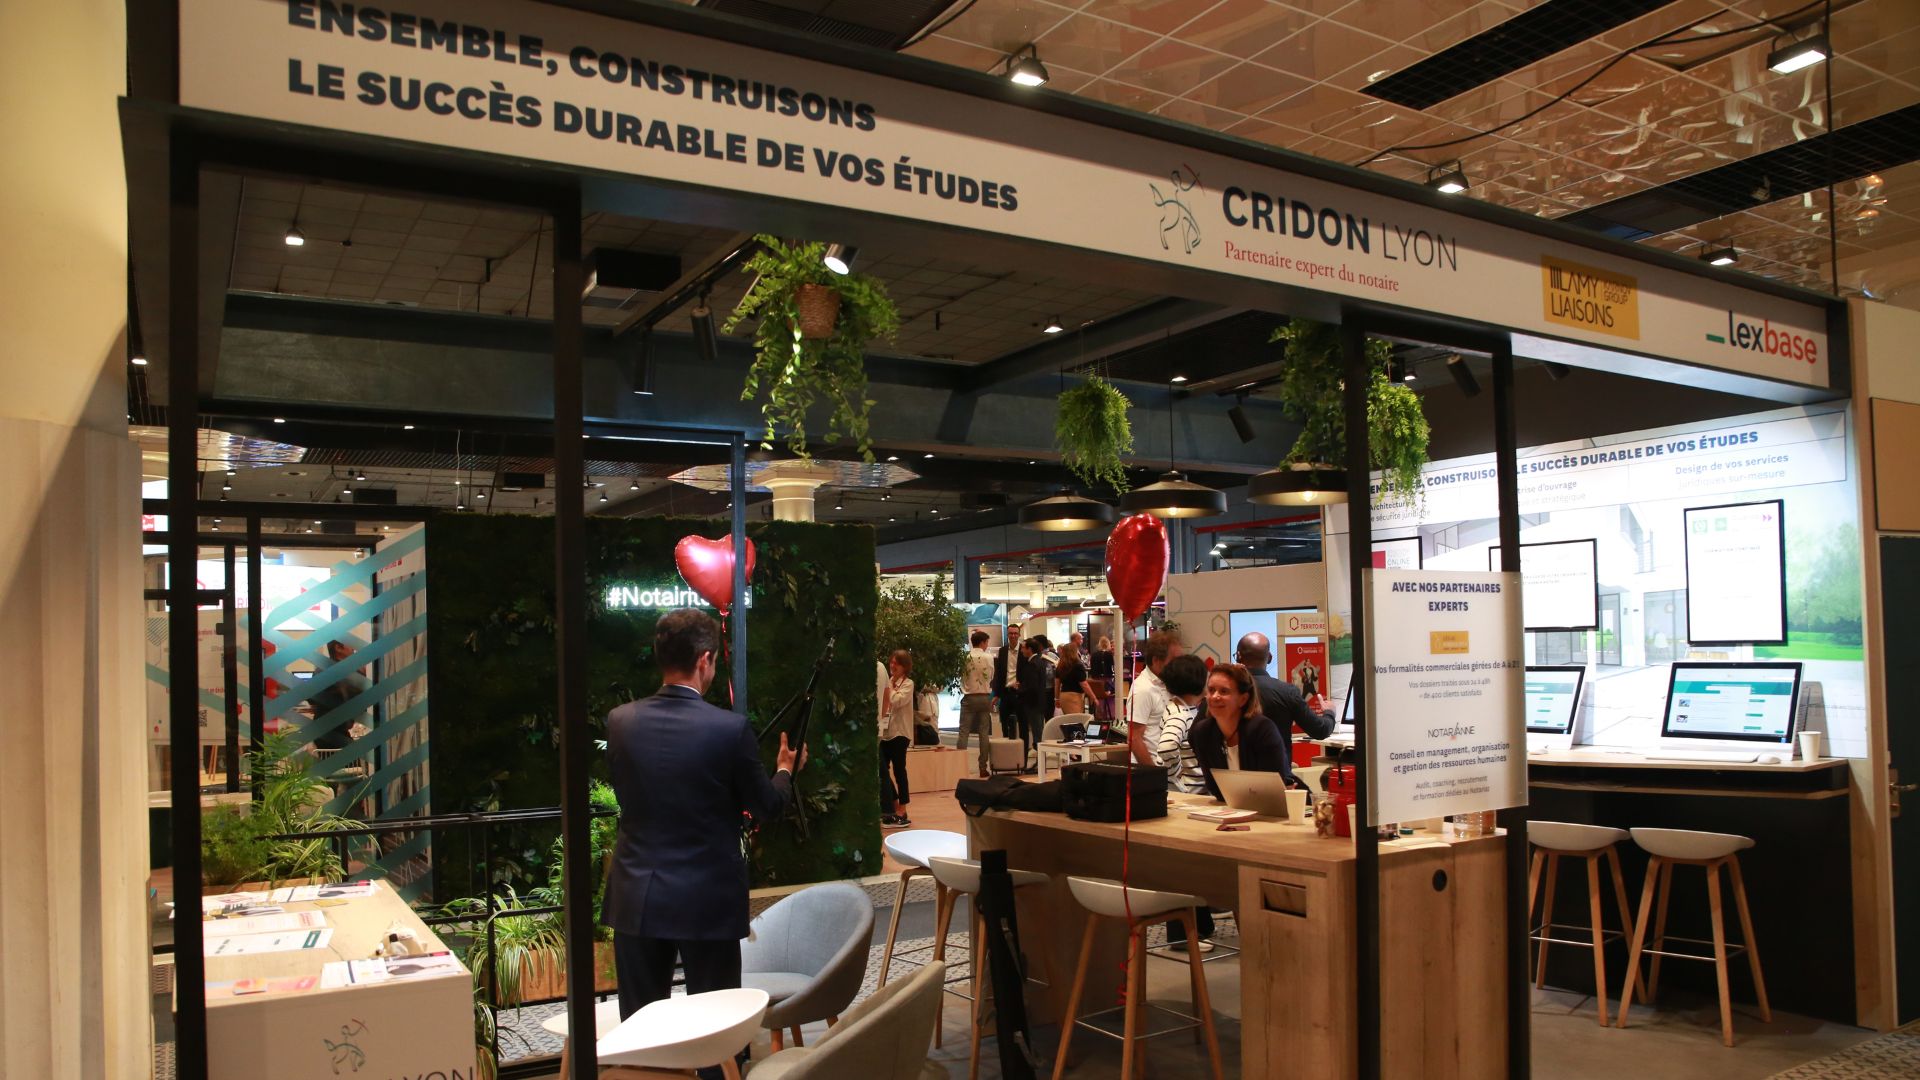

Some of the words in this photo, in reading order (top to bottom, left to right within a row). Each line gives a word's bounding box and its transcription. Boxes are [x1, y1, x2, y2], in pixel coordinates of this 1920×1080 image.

[288, 0, 558, 76] ENSEMBLE,
[569, 46, 876, 132] CONSTRUISONS
[288, 58, 346, 101] LE
[357, 70, 543, 128] SUCCÈS
[554, 101, 748, 164] DURABLE
[756, 138, 805, 173] DE
[813, 147, 886, 187] VOS
[893, 156, 1019, 212] ÉTUDES
[1222, 185, 1370, 255] CRIDON
[1381, 221, 1458, 272] LYON
[1224, 240, 1293, 270] Partenaire
[1295, 257, 1336, 279] expert
[1338, 263, 1355, 284] du
[1358, 270, 1400, 292] notaire
[1551, 292, 1615, 328] LIAISONS
[1728, 309, 1818, 365] lexbase
[1427, 468, 1497, 487] CONSTRUISO
[1530, 455, 1578, 473] SUCCÈS
[1580, 448, 1642, 466] DURABLE
[1645, 444, 1664, 457] DE
[1666, 440, 1696, 454] VOS
[1699, 431, 1759, 449] ÉTUDES
[1675, 464, 1708, 475] Design
[1710, 462, 1723, 471] de
[1725, 461, 1743, 469] vos
[1745, 454, 1789, 467] services
[1537, 480, 1577, 492] d'ouvrage
[1728, 469, 1786, 483] sur-mesure
[1392, 581, 1417, 593] AVEC
[1418, 582, 1438, 593] NOS
[1440, 583, 1501, 594] PARTENAIRES
[1428, 601, 1469, 612] EXPERTS
[1374, 665, 1388, 674] Vos
[1388, 662, 1424, 674] formalités
[1425, 660, 1470, 672] commerciales
[1471, 660, 1492, 672] gérées
[1492, 660, 1501, 669] de
[1408, 680, 1419, 689] Vos
[1389, 750, 1415, 761] Conseil
[1416, 750, 1425, 758] en
[1426, 745, 1471, 758] management,
[1471, 741, 1510, 754] organisation
[1393, 764, 1402, 773] et
[1402, 762, 1428, 774] gestion
[1428, 761, 1441, 769] des
[1441, 758, 1477, 769] ressources
[1477, 754, 1507, 764] humaines
